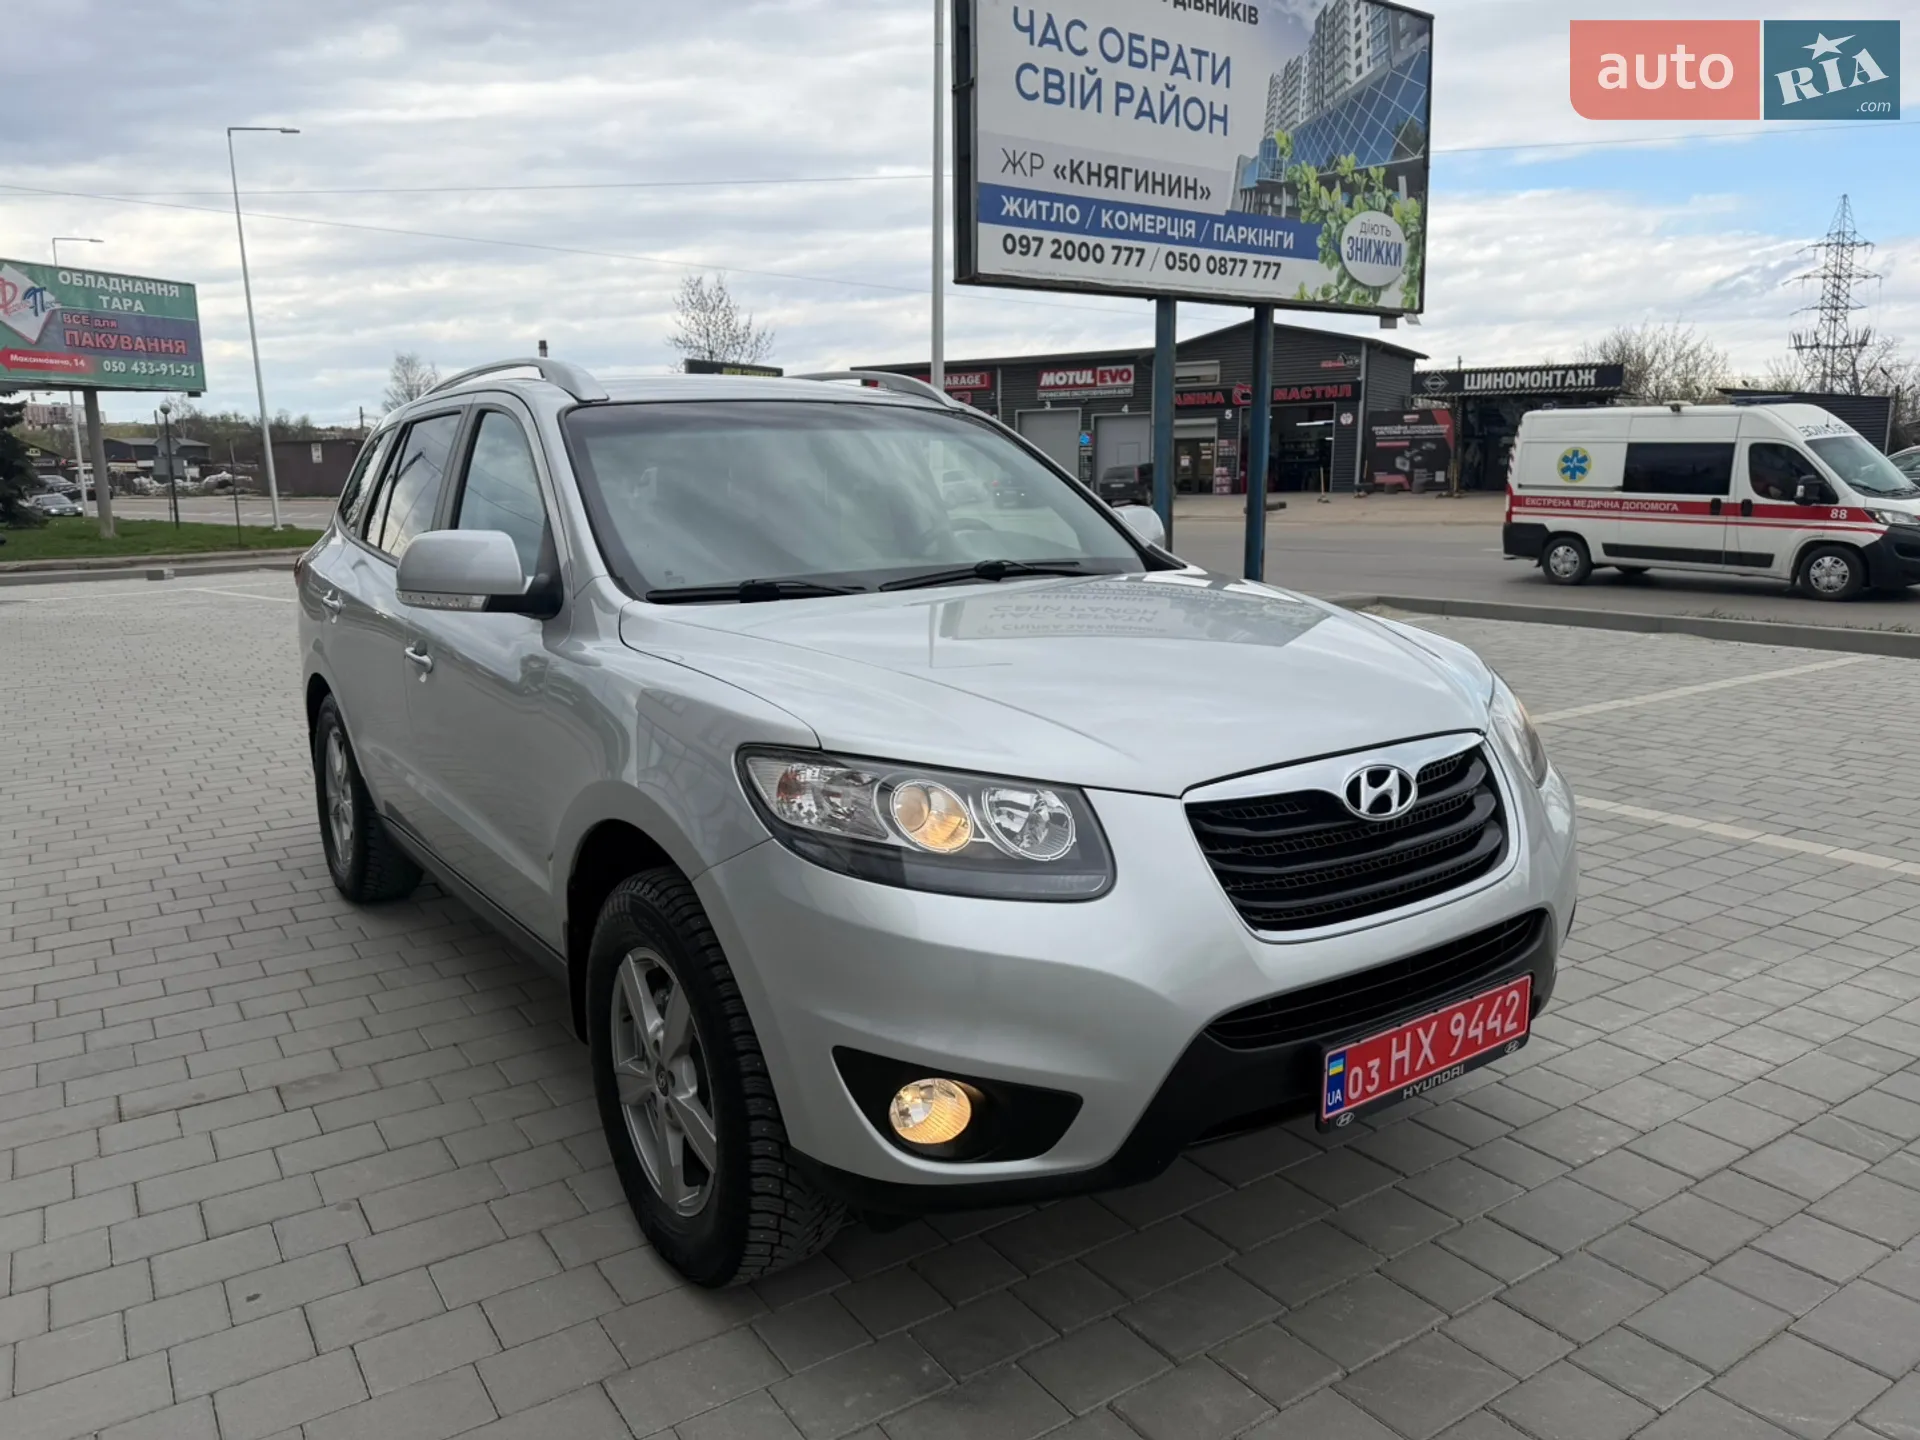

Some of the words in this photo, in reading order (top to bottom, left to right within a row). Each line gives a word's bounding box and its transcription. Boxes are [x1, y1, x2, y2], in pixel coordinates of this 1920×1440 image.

[1012, 7, 1089, 57] ЧАС
[1099, 26, 1231, 88] ОБРАТИ
[1015, 61, 1103, 114] СВІЙ
[1114, 82, 1229, 136] РАЙОН
[1000, 148, 1044, 178] ЖР
[1053, 159, 1211, 201] «КНЯГИНИН»
[1001, 195, 1080, 225] ЖИТЛО
[1101, 209, 1196, 240] КОМЕРЦІЯ
[1213, 223, 1294, 250] ПАРКІНГИ
[1002, 233, 1044, 258] 097
[1050, 240, 1105, 264] 2000
[1111, 246, 1145, 268] 777
[1164, 251, 1201, 273] 050
[1206, 255, 1249, 277] 0877
[1252, 260, 1282, 281] 777
[1346, 236, 1403, 268] ЗНИЖКИ
[58, 270, 180, 298] ОБЛАДНАННЯ
[98, 295, 145, 313] ТАРА
[63, 313, 91, 326] ВСЕ
[92, 319, 118, 329] для
[65, 330, 187, 354] ПАКУВАННЯ
[74, 359, 86, 367] 14
[103, 360, 126, 374] 050
[131, 361, 196, 378] 433-91-21
[943, 375, 981, 386] ARAGE
[1040, 370, 1095, 387] MOTUL
[1098, 368, 1132, 384] EVO
[1463, 369, 1597, 391] ШИНОМОНТАЖ
[1173, 391, 1225, 406] АМІНА
[1273, 384, 1352, 401] МАСТИЛ
[1224, 409, 1232, 420] 5
[1524, 496, 1571, 508] ЕКСТРЕНА
[1573, 498, 1620, 511] МЕДИЧНА
[1622, 501, 1679, 512] ДОПОМОГА
[1829, 508, 1847, 519] 88
[1348, 1058, 1380, 1100] 03
[1389, 1021, 1438, 1082] HX
[1449, 989, 1520, 1057] 9442
[1403, 1064, 1464, 1100] HYUNDAI
[1327, 1090, 1343, 1106] UA
